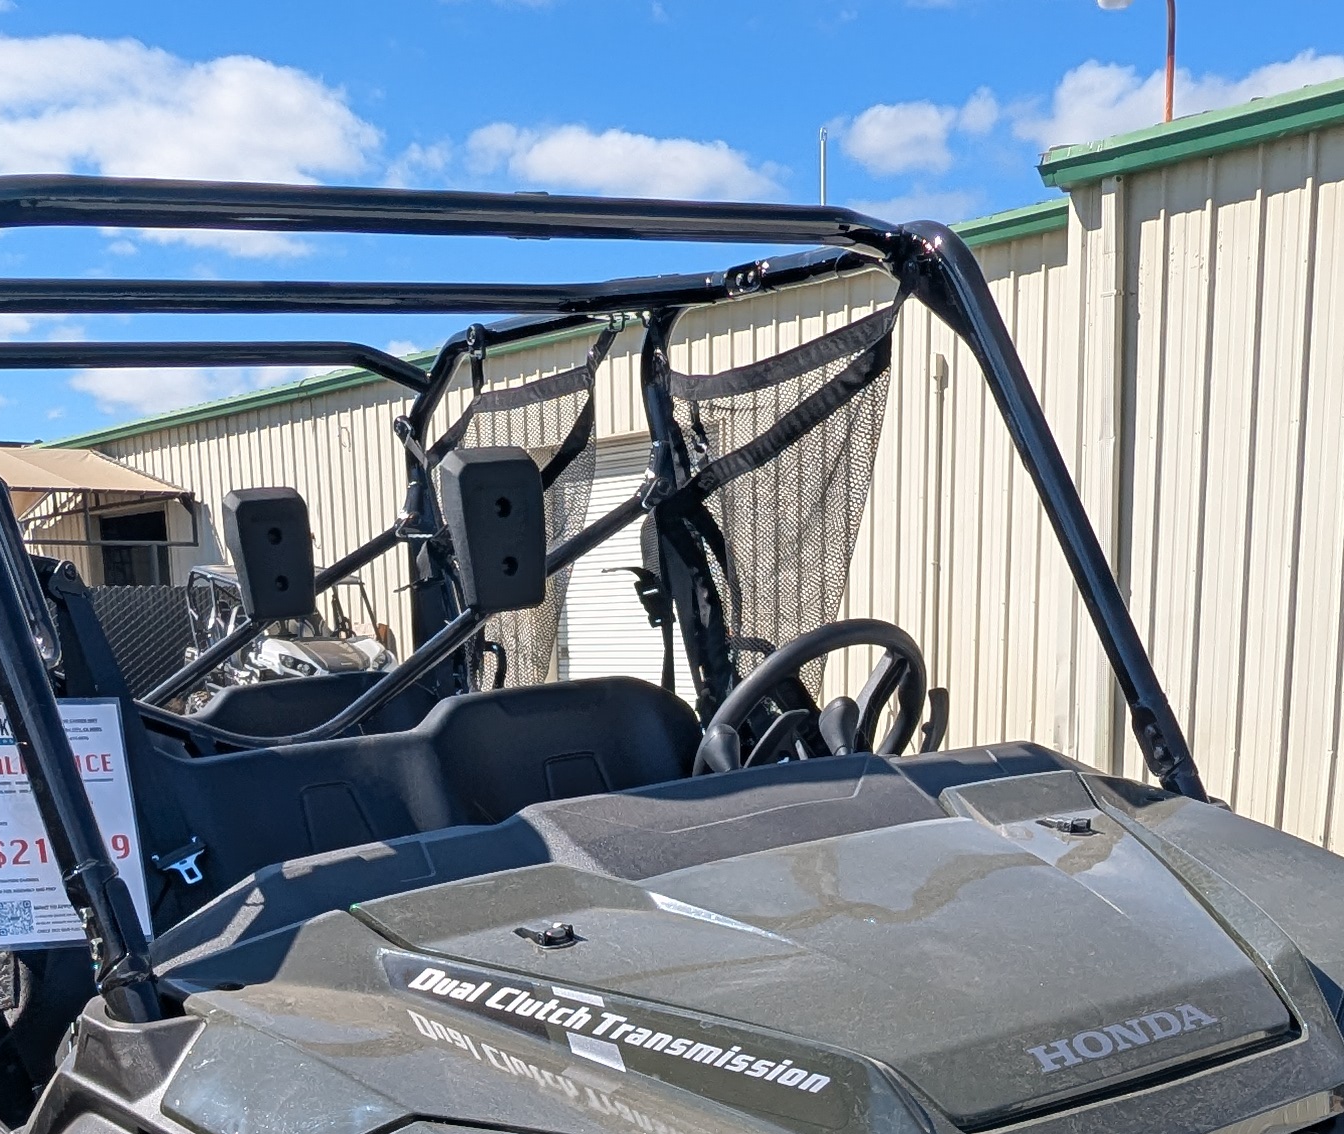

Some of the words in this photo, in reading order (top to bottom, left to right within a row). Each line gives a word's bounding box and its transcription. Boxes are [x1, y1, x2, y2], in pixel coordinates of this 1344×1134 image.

[407, 967, 488, 1003] Dual
[485, 985, 593, 1031] Clutch
[591, 1012, 832, 1094] Transmission
[1025, 1003, 1218, 1073] HONDA
